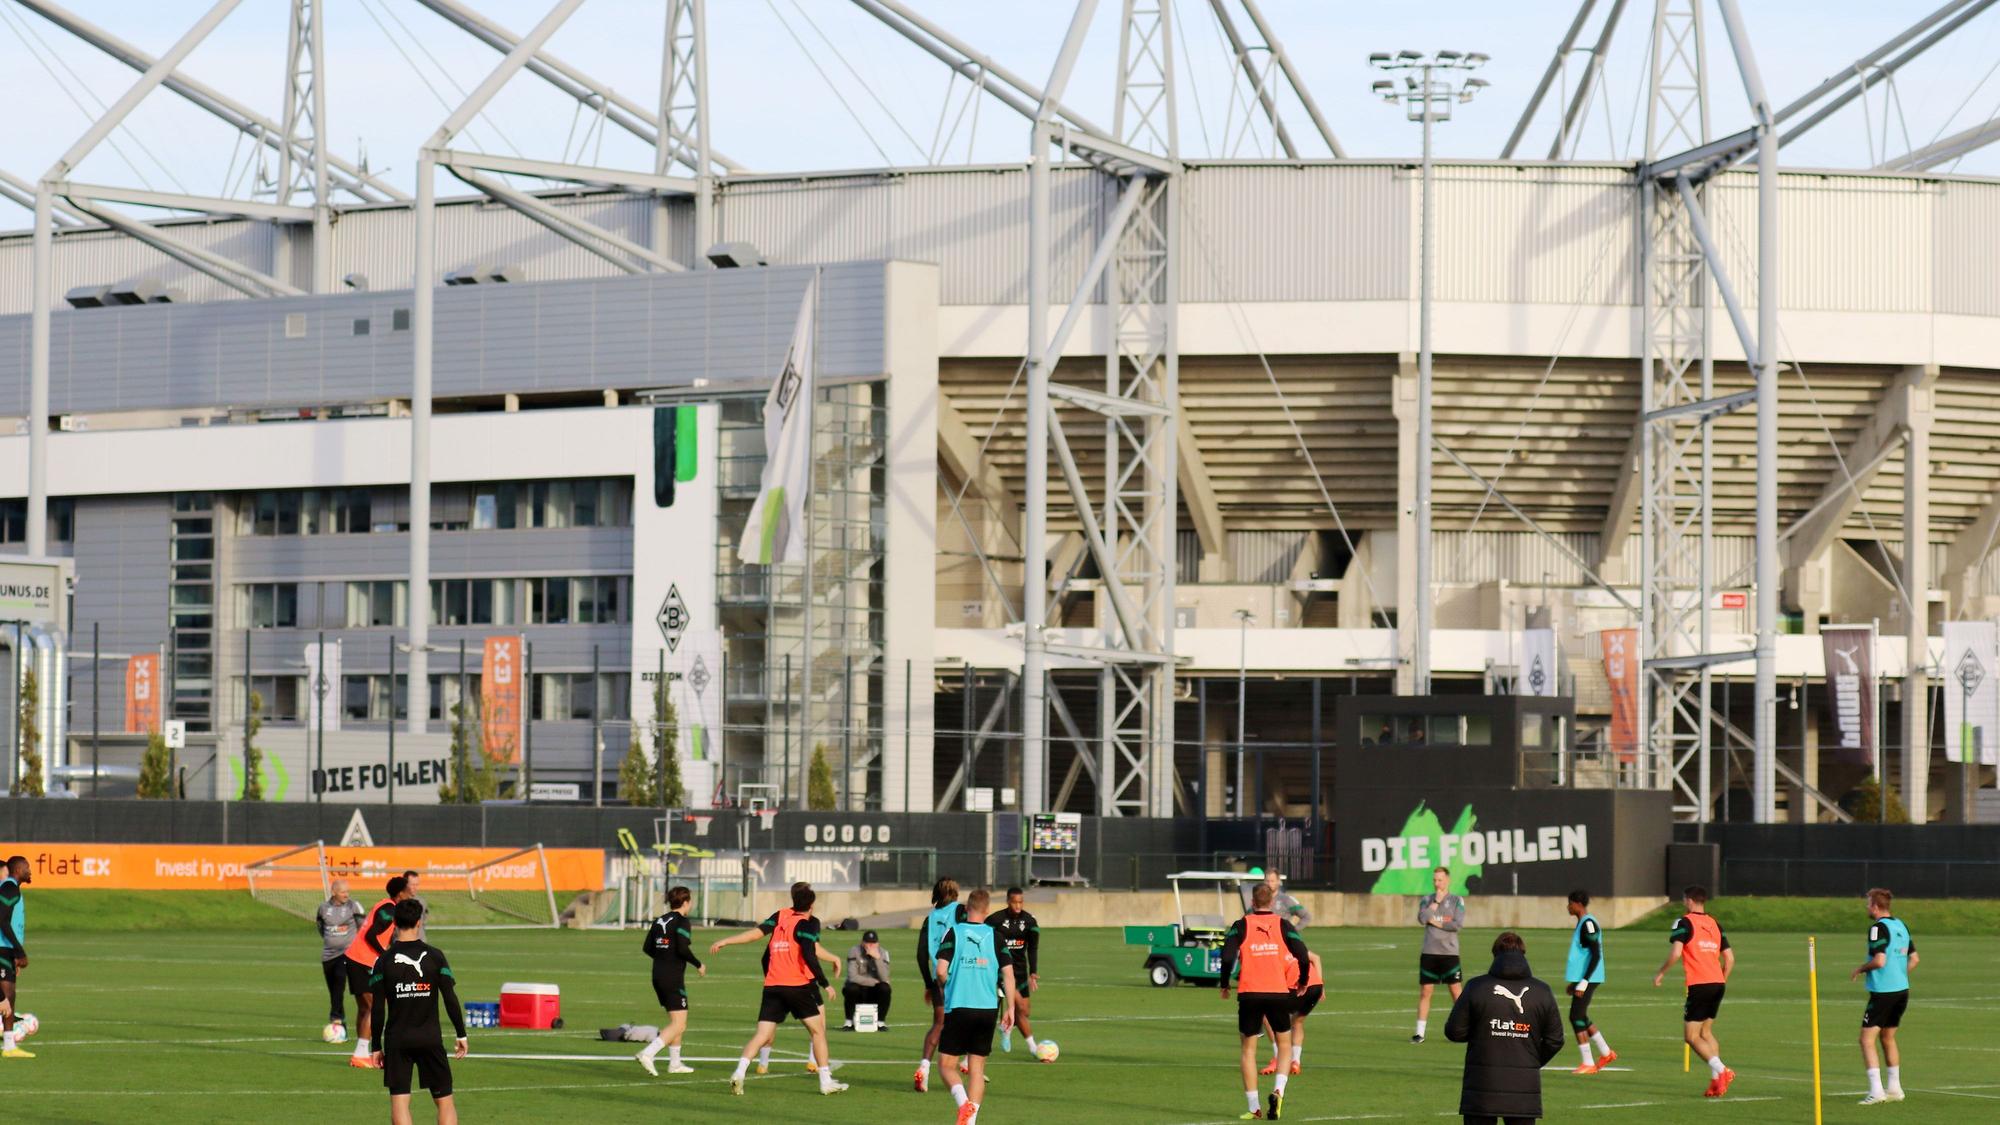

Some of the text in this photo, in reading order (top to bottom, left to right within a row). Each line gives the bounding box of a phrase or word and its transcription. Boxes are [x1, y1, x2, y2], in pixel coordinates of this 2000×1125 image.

[1836, 674, 1861, 748] PUMA
[171, 728, 179, 740] 2
[312, 758, 447, 794] DIE FOHLEN
[1361, 824, 1588, 873] DIE FOHLEN
[155, 858, 198, 877] Invest
[201, 858, 215, 877] in
[785, 860, 832, 884] PUMA
